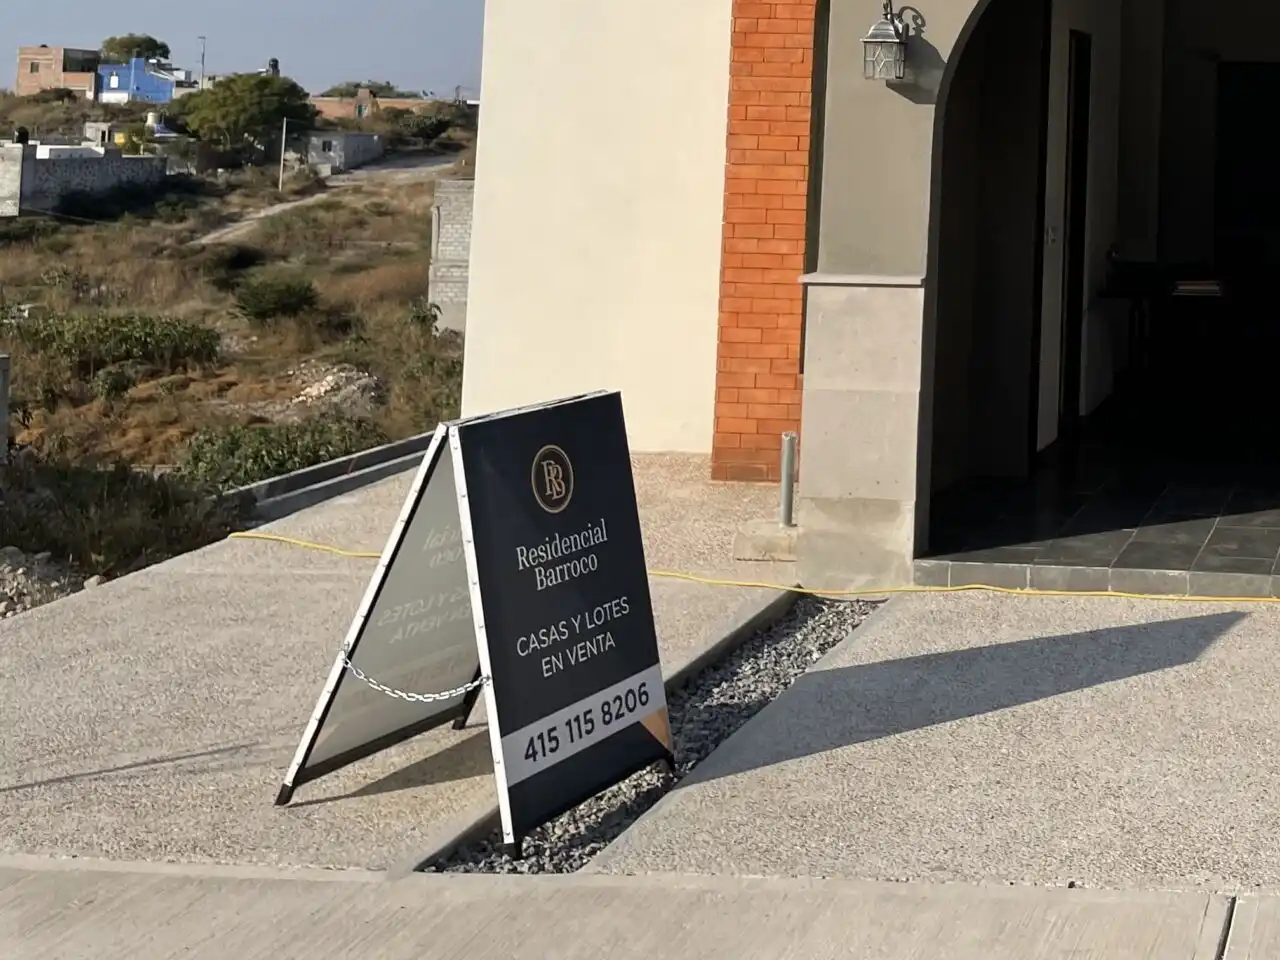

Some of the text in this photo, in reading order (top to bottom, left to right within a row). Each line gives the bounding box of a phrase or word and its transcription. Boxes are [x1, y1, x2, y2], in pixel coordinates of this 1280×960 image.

[516, 518, 608, 570] Residencial
[534, 553, 598, 591] Barroco
[516, 596, 630, 657] CASAS Y LOTES
[541, 631, 616, 678] EN VENTA
[524, 682, 649, 762] 415 115 8206
